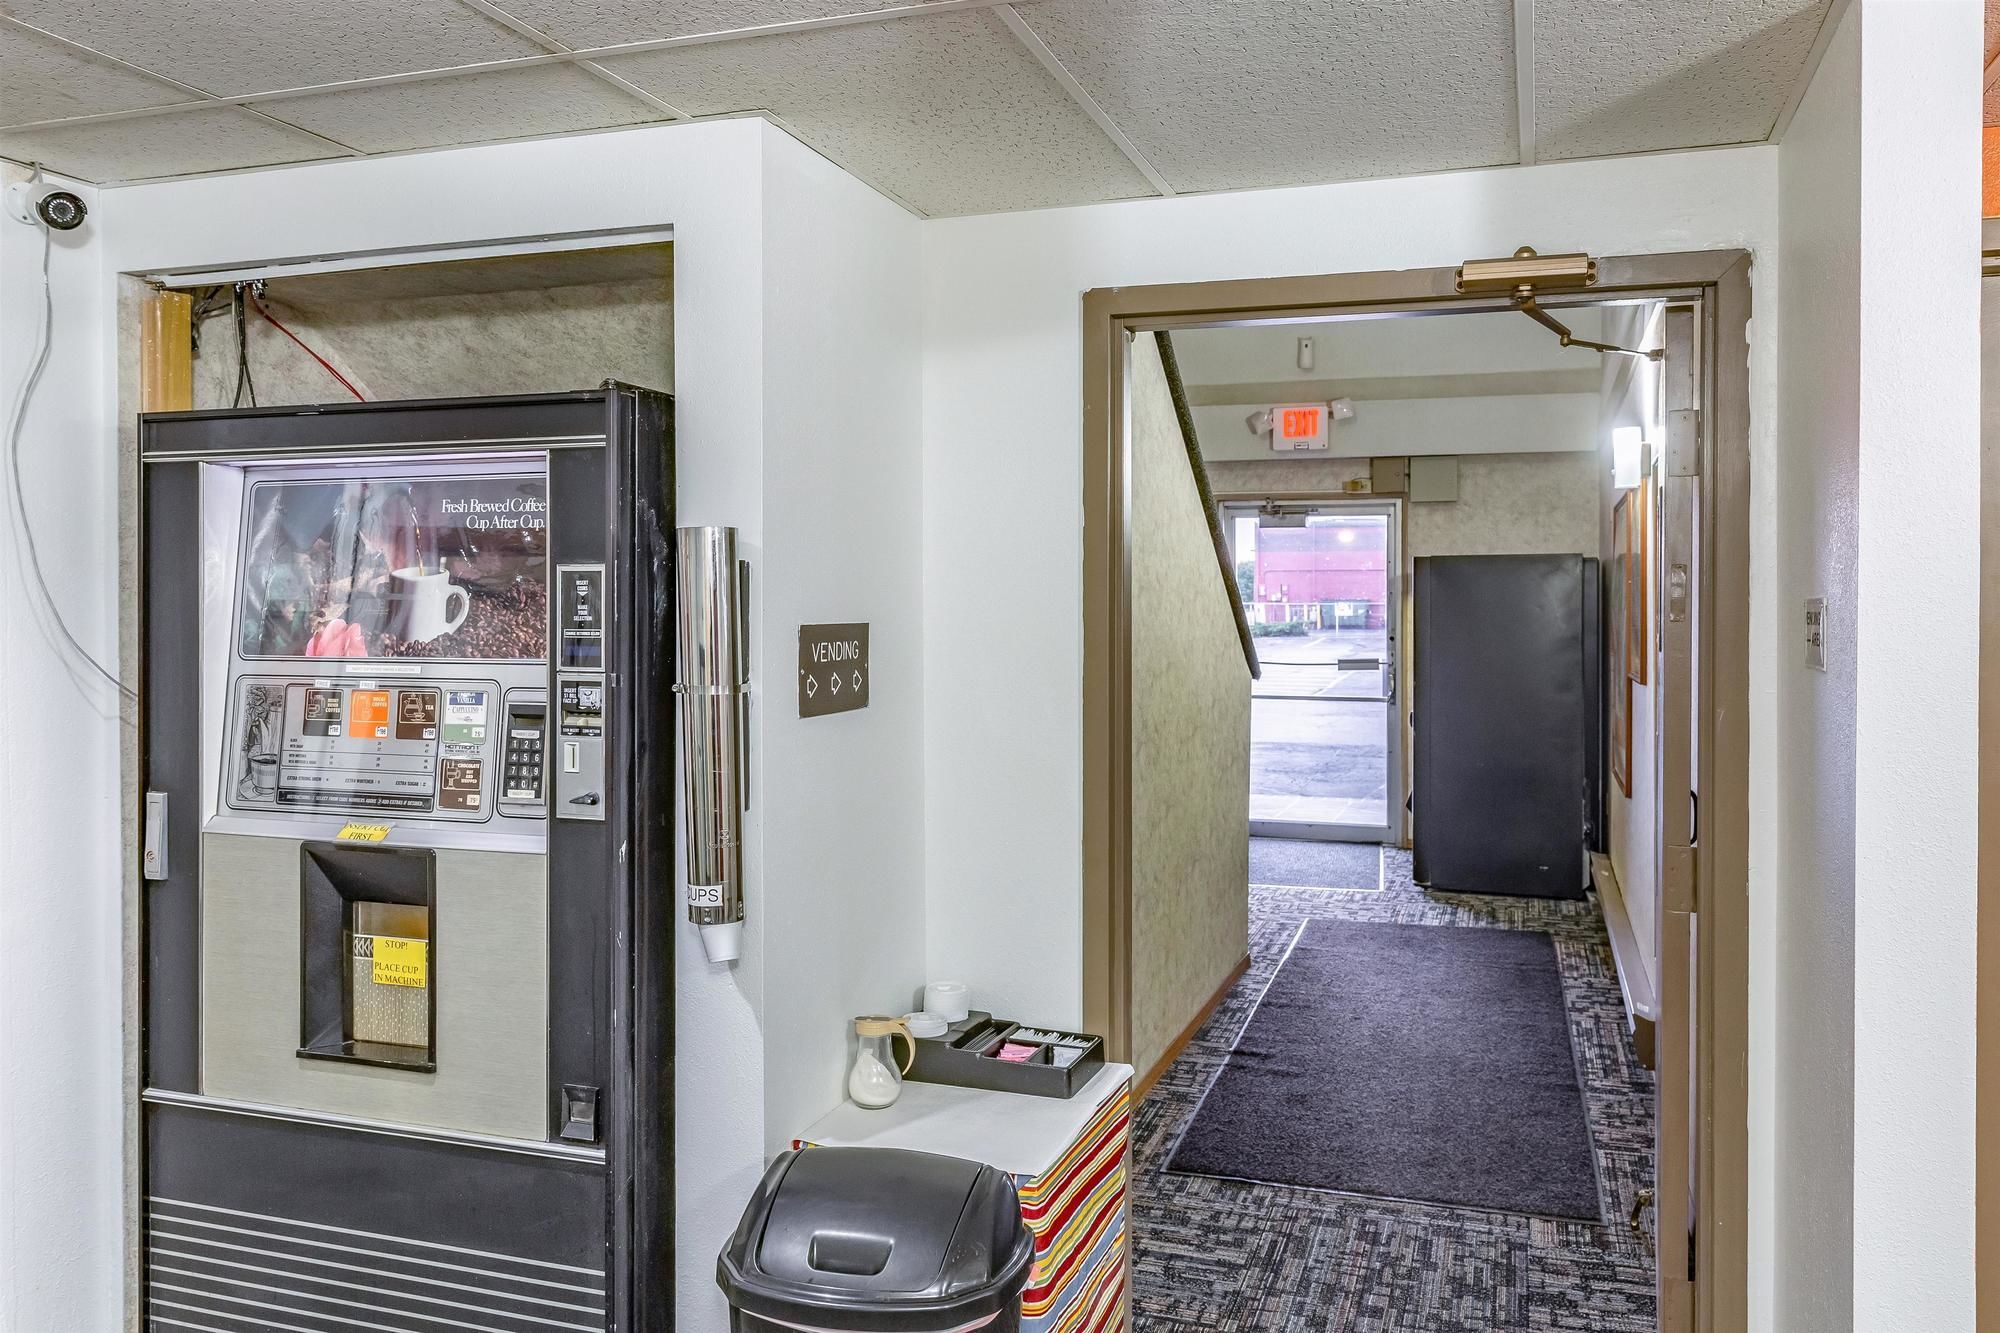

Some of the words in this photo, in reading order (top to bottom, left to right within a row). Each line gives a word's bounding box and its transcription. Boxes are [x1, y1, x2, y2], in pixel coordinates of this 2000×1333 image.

[1283, 409, 1319, 438] EXIT
[441, 499, 468, 513] Fresh
[470, 498, 509, 513] Brewed
[511, 497, 546, 512] Coffee
[466, 515, 489, 532] Cup
[490, 515, 518, 529] After
[520, 514, 545, 531] Cup.
[811, 640, 859, 663] VENDING
[513, 740, 517, 748] 1
[524, 740, 529, 748] 2
[523, 753, 528, 761] 5
[534, 753, 540, 762] 6
[511, 766, 516, 774] 7
[522, 767, 527, 775] 8
[533, 767, 539, 775] 9
[521, 780, 526, 788] 0
[348, 831, 376, 841] FIRST
[384, 939, 409, 951] STOP!
[374, 961, 401, 973] PLACE
[401, 965, 419, 974] CUP
[374, 973, 384, 982] IN
[384, 974, 425, 987] MACHINE
